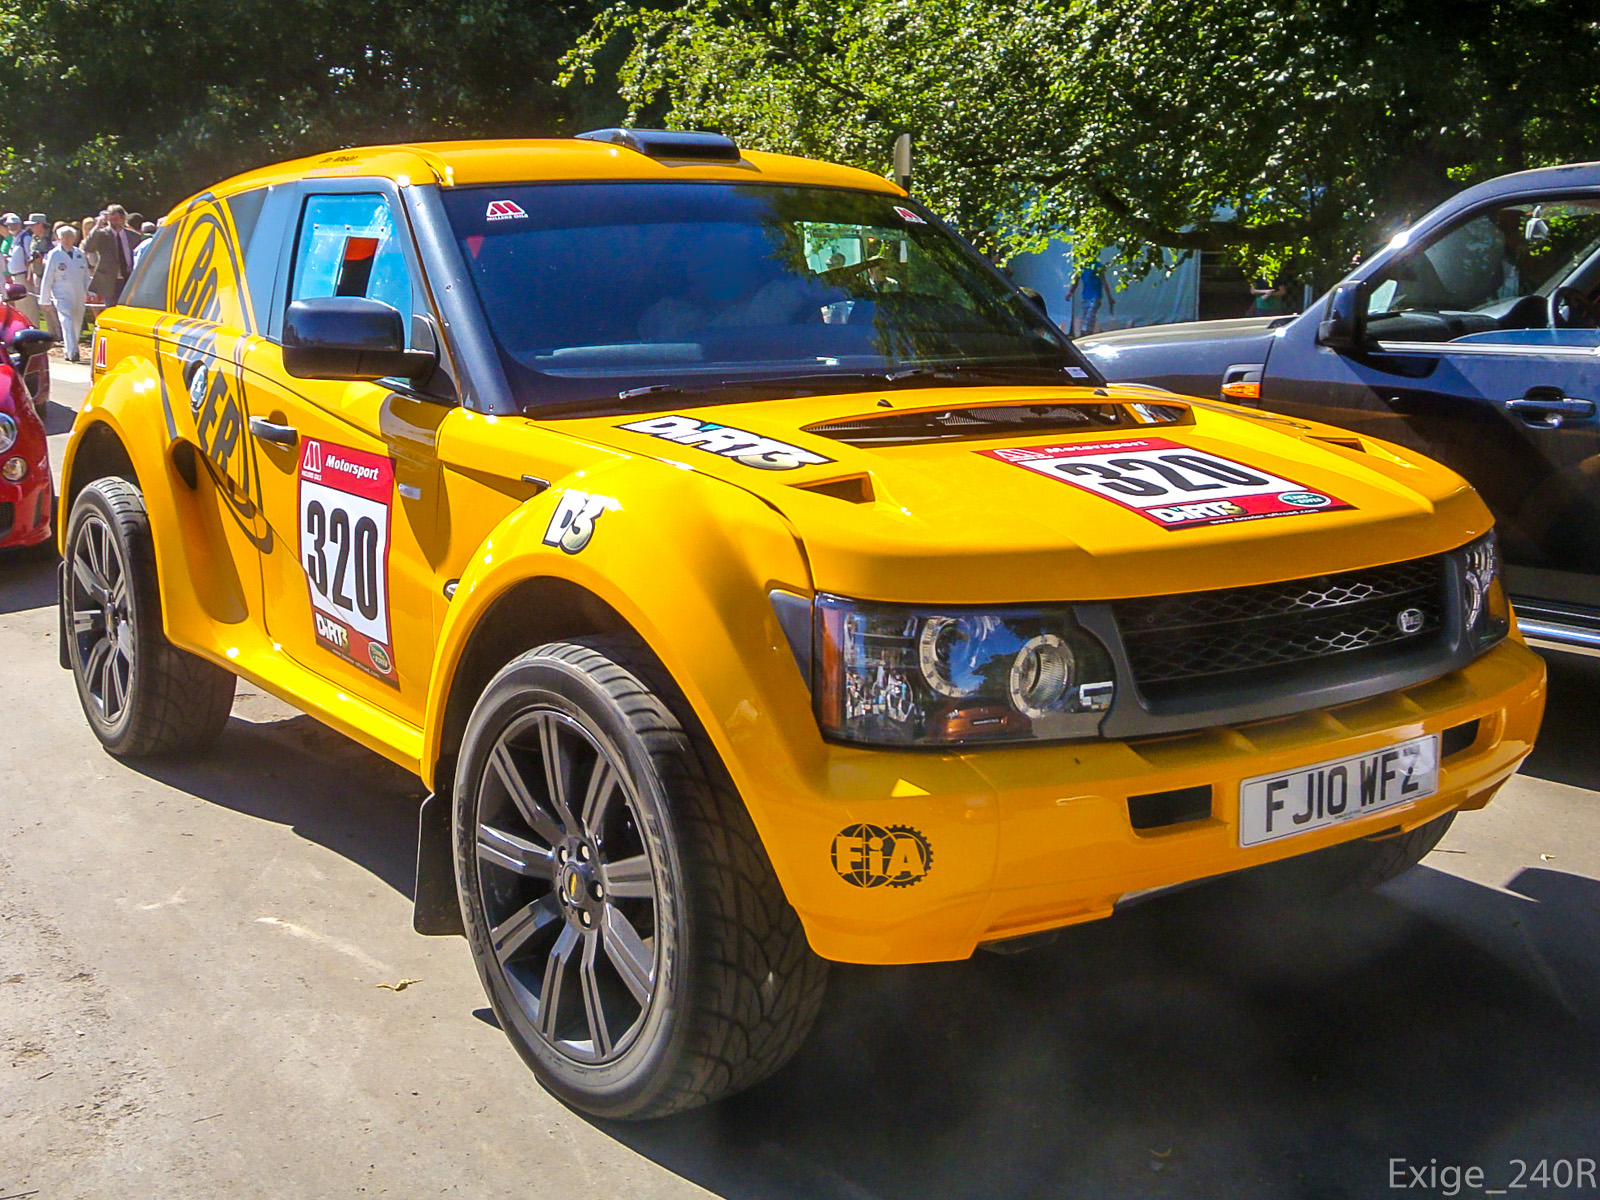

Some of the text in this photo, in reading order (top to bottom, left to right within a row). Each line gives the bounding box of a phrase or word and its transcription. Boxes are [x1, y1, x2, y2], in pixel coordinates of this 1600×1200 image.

[326, 454, 379, 481] Motorsport
[1044, 440, 1148, 453] Motorsport
[1054, 454, 1270, 497] 320
[542, 488, 622, 555] D3
[307, 500, 379, 621] 320
[1265, 744, 1421, 833] FJ10 WFZ
